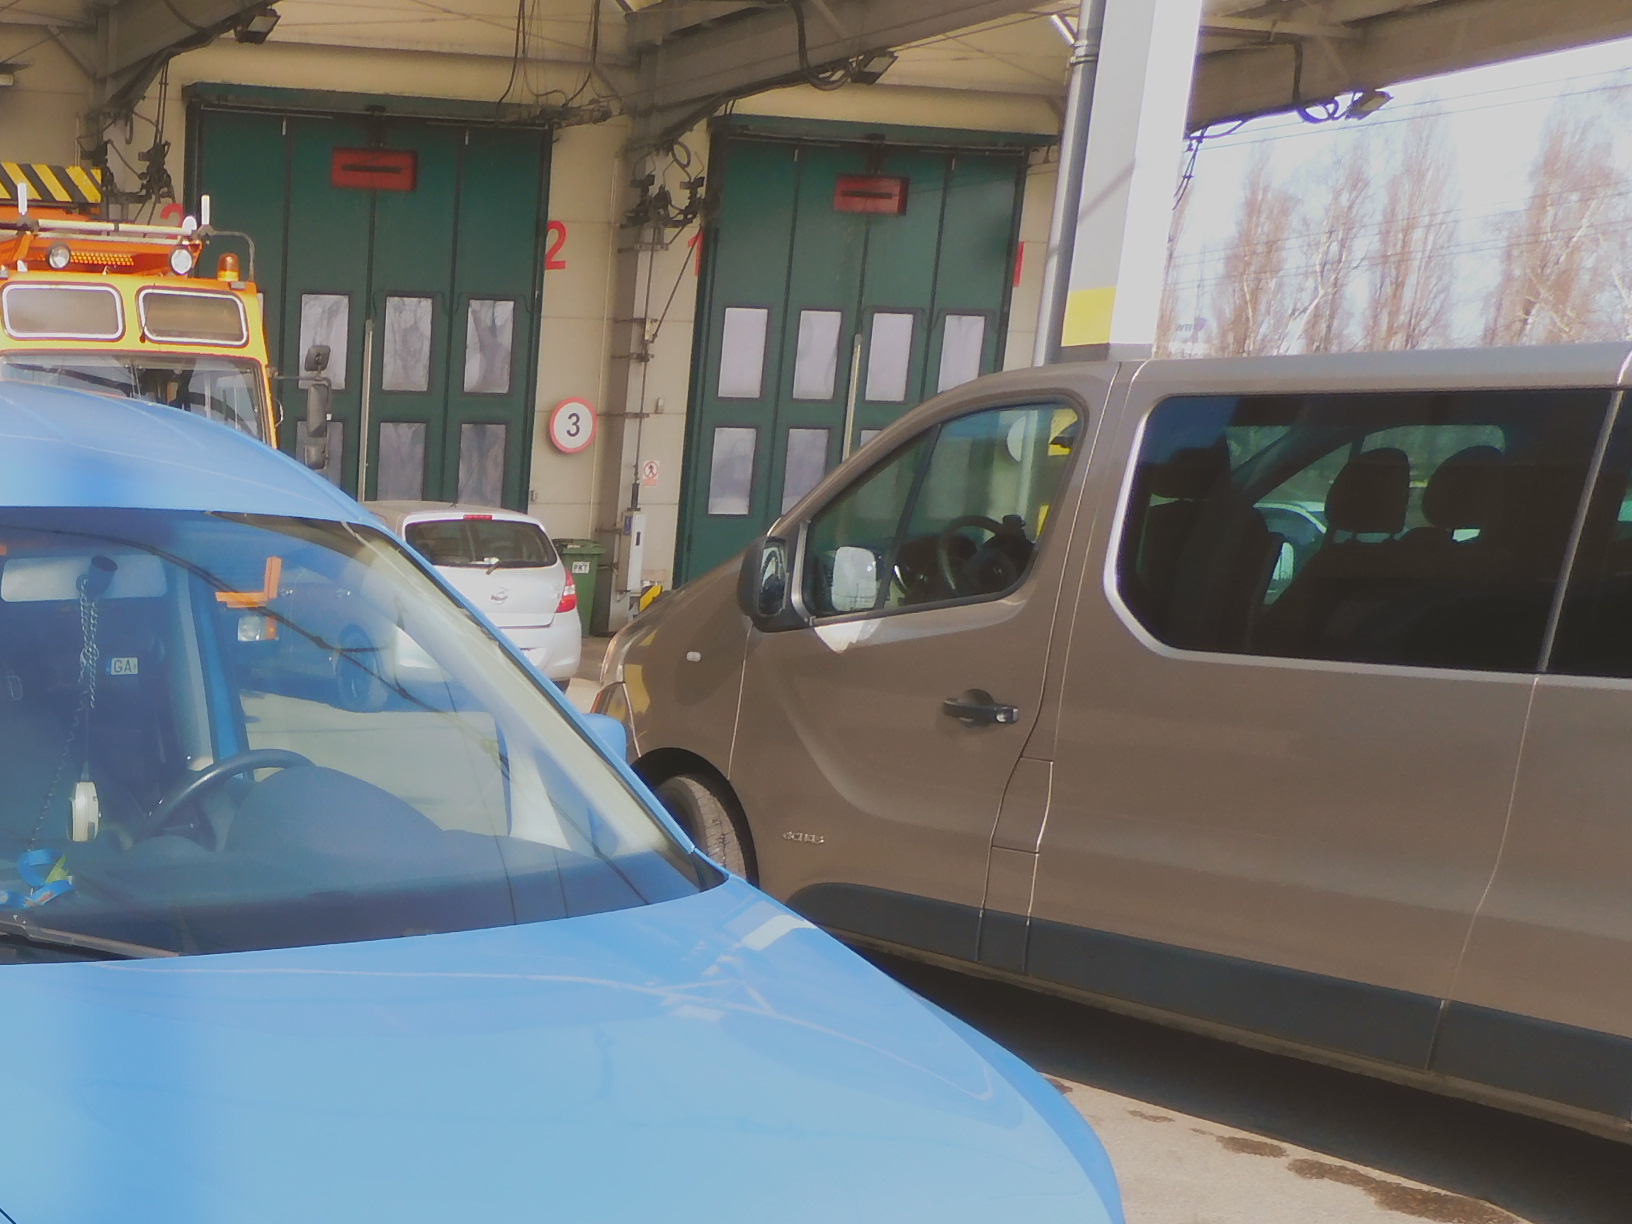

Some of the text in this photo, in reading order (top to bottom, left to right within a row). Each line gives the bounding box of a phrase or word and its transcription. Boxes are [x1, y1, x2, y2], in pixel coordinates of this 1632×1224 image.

[545, 221, 567, 270] 2
[566, 412, 581, 437] 3
[114, 659, 132, 673] GA
